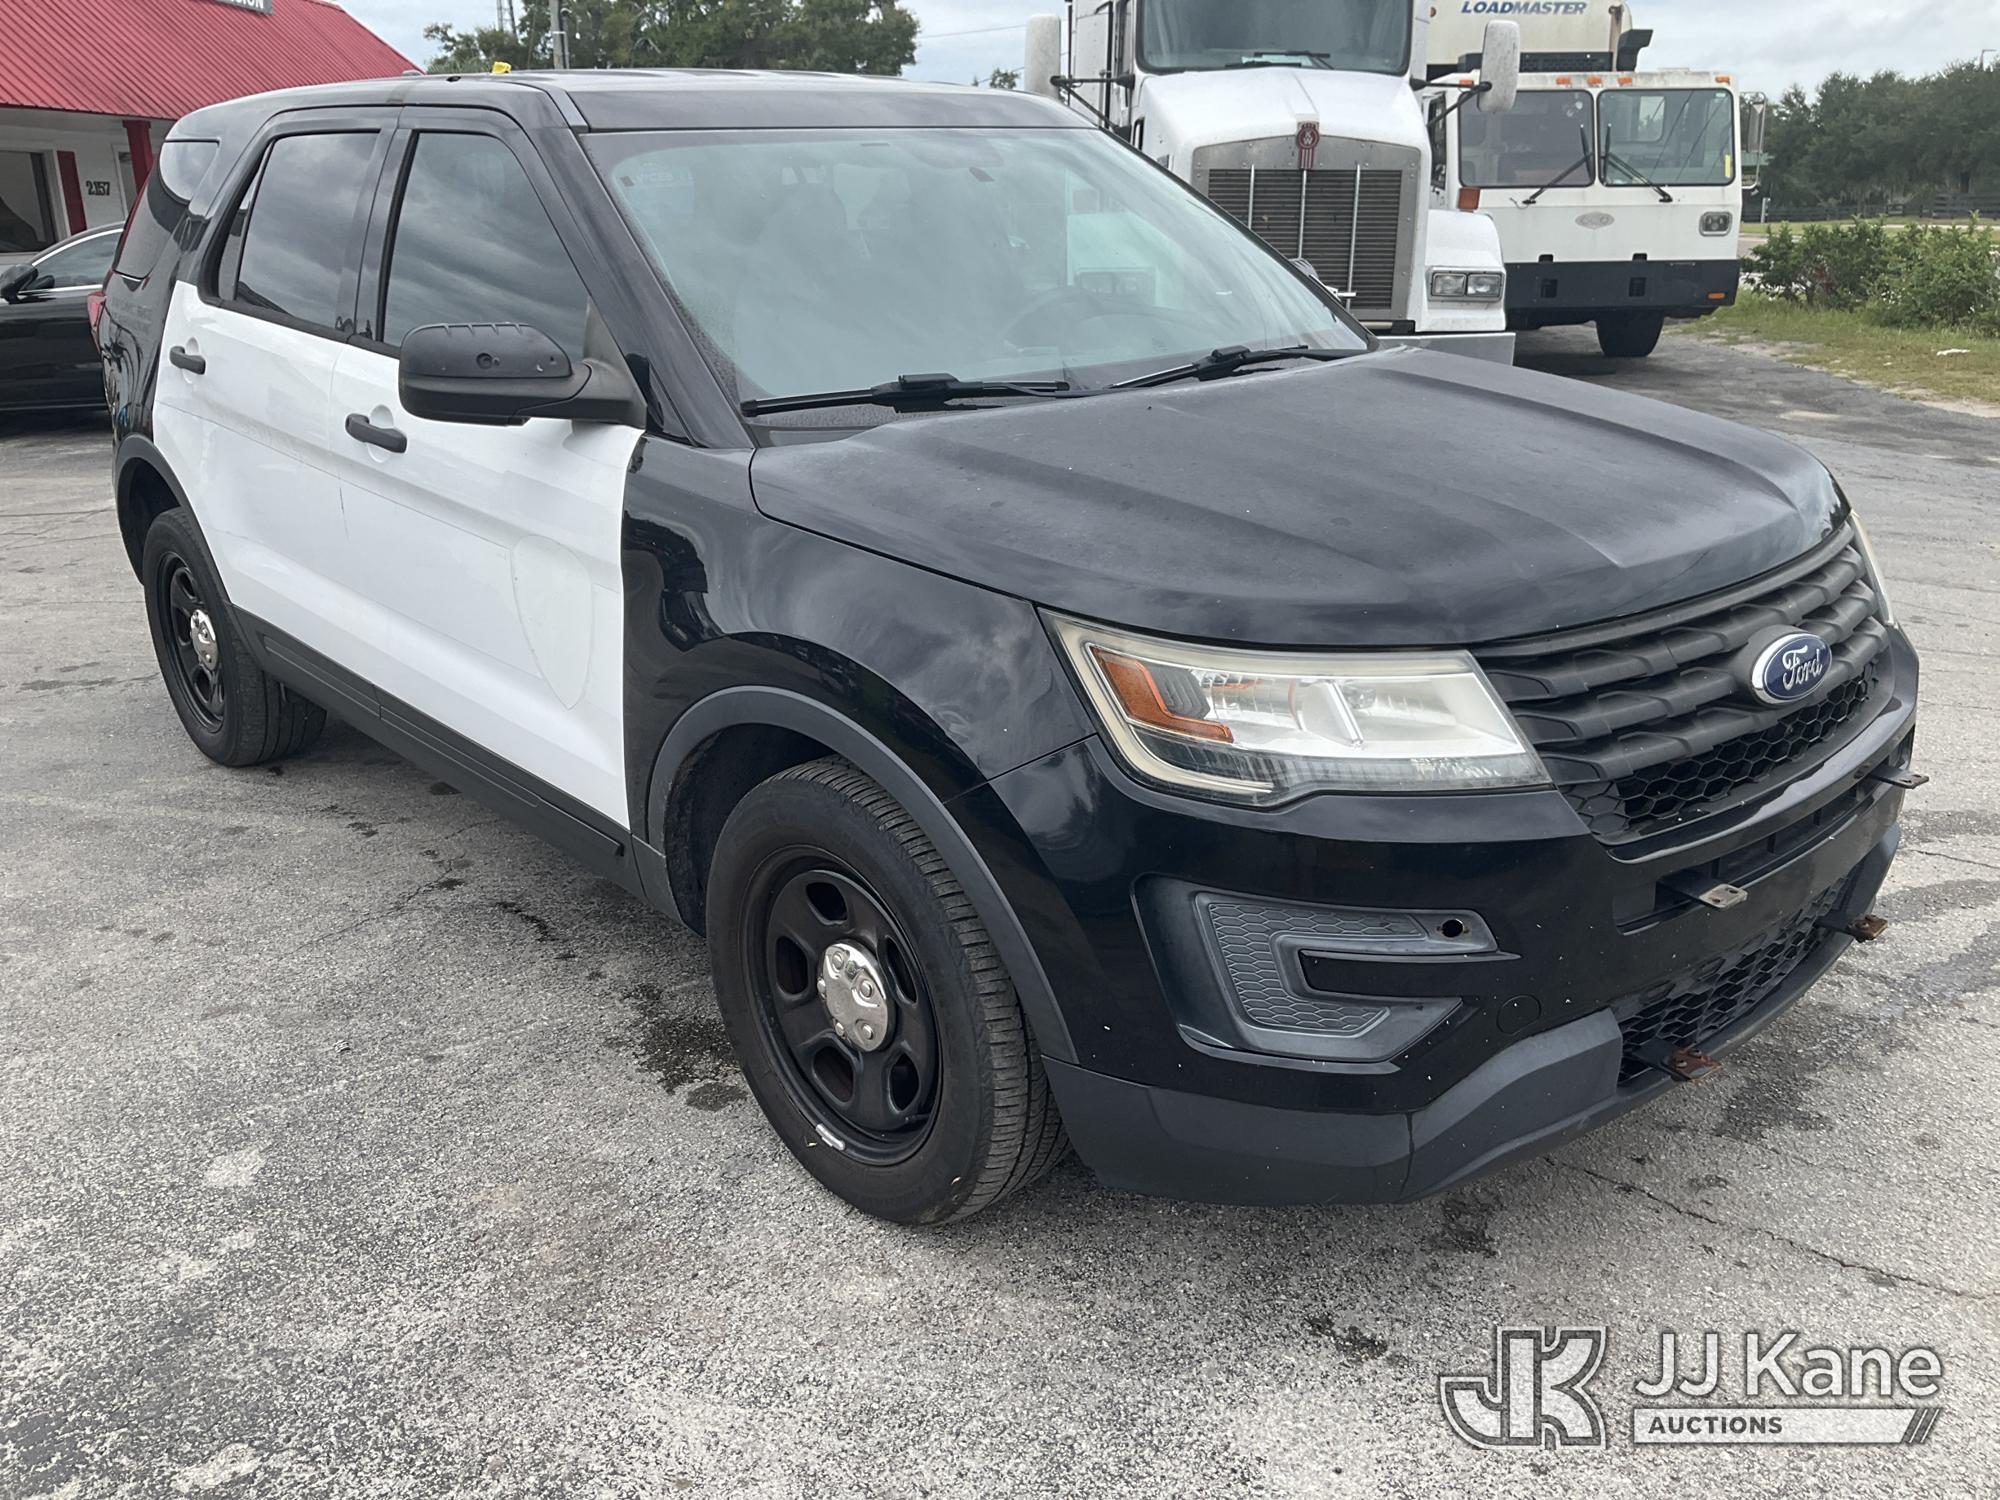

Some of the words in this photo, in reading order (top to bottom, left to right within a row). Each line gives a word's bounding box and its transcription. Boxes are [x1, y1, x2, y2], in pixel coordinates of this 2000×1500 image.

[1461, 1, 1587, 14] LOADMASTER
[86, 180, 110, 196] 2157
[1782, 645, 1823, 690] Ford
